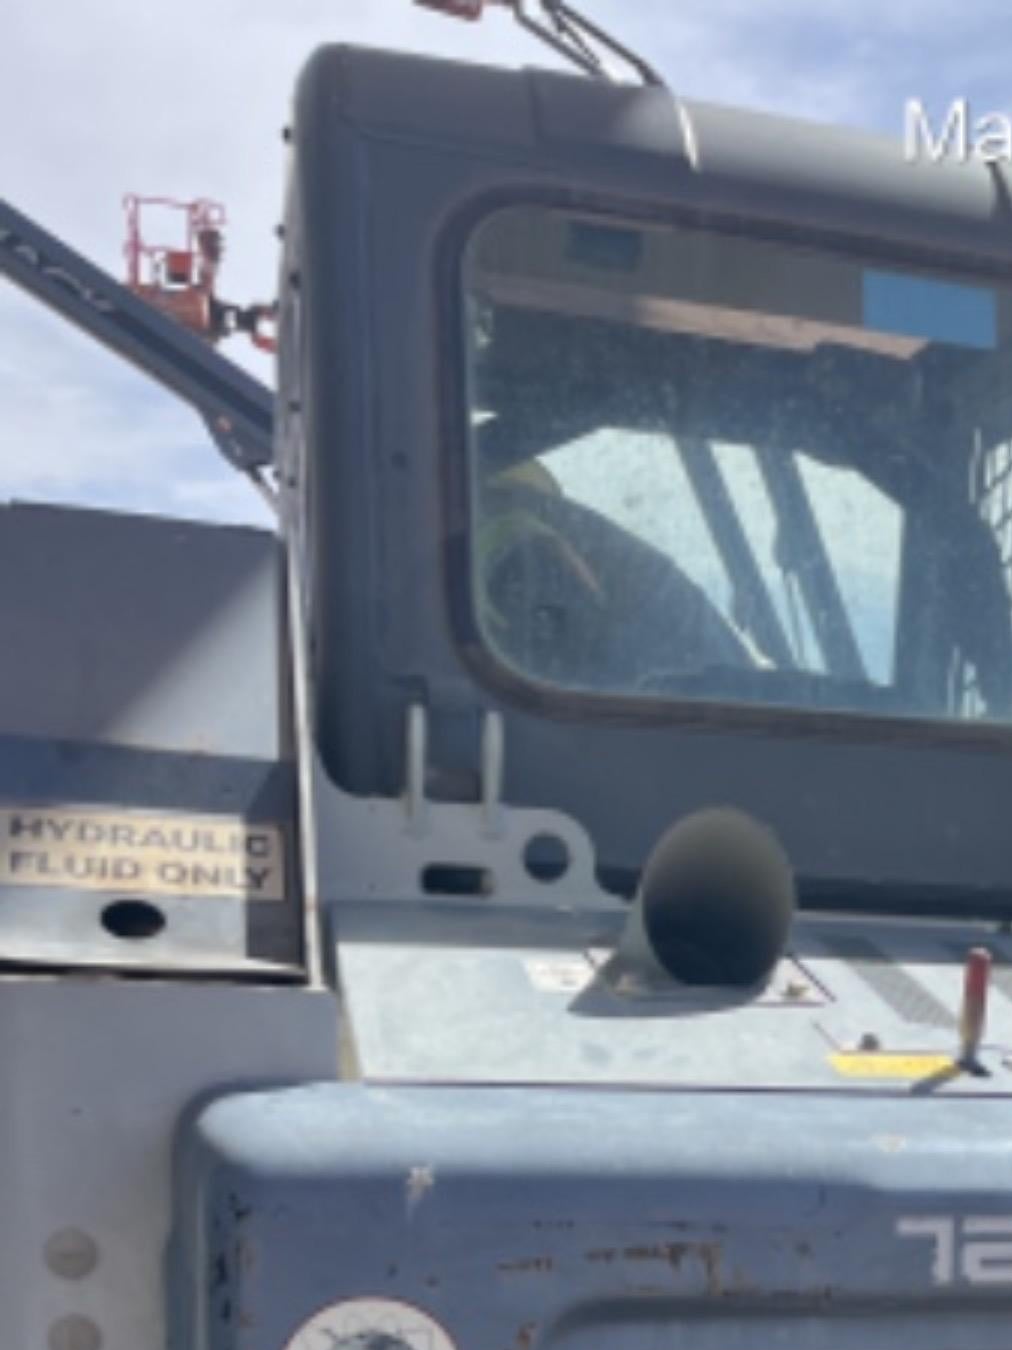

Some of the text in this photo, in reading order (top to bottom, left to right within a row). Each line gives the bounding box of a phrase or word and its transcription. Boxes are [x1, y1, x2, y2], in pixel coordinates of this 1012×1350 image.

[10, 815, 268, 858] HYDRAULIC
[10, 850, 269, 890] FLUID ONLY
